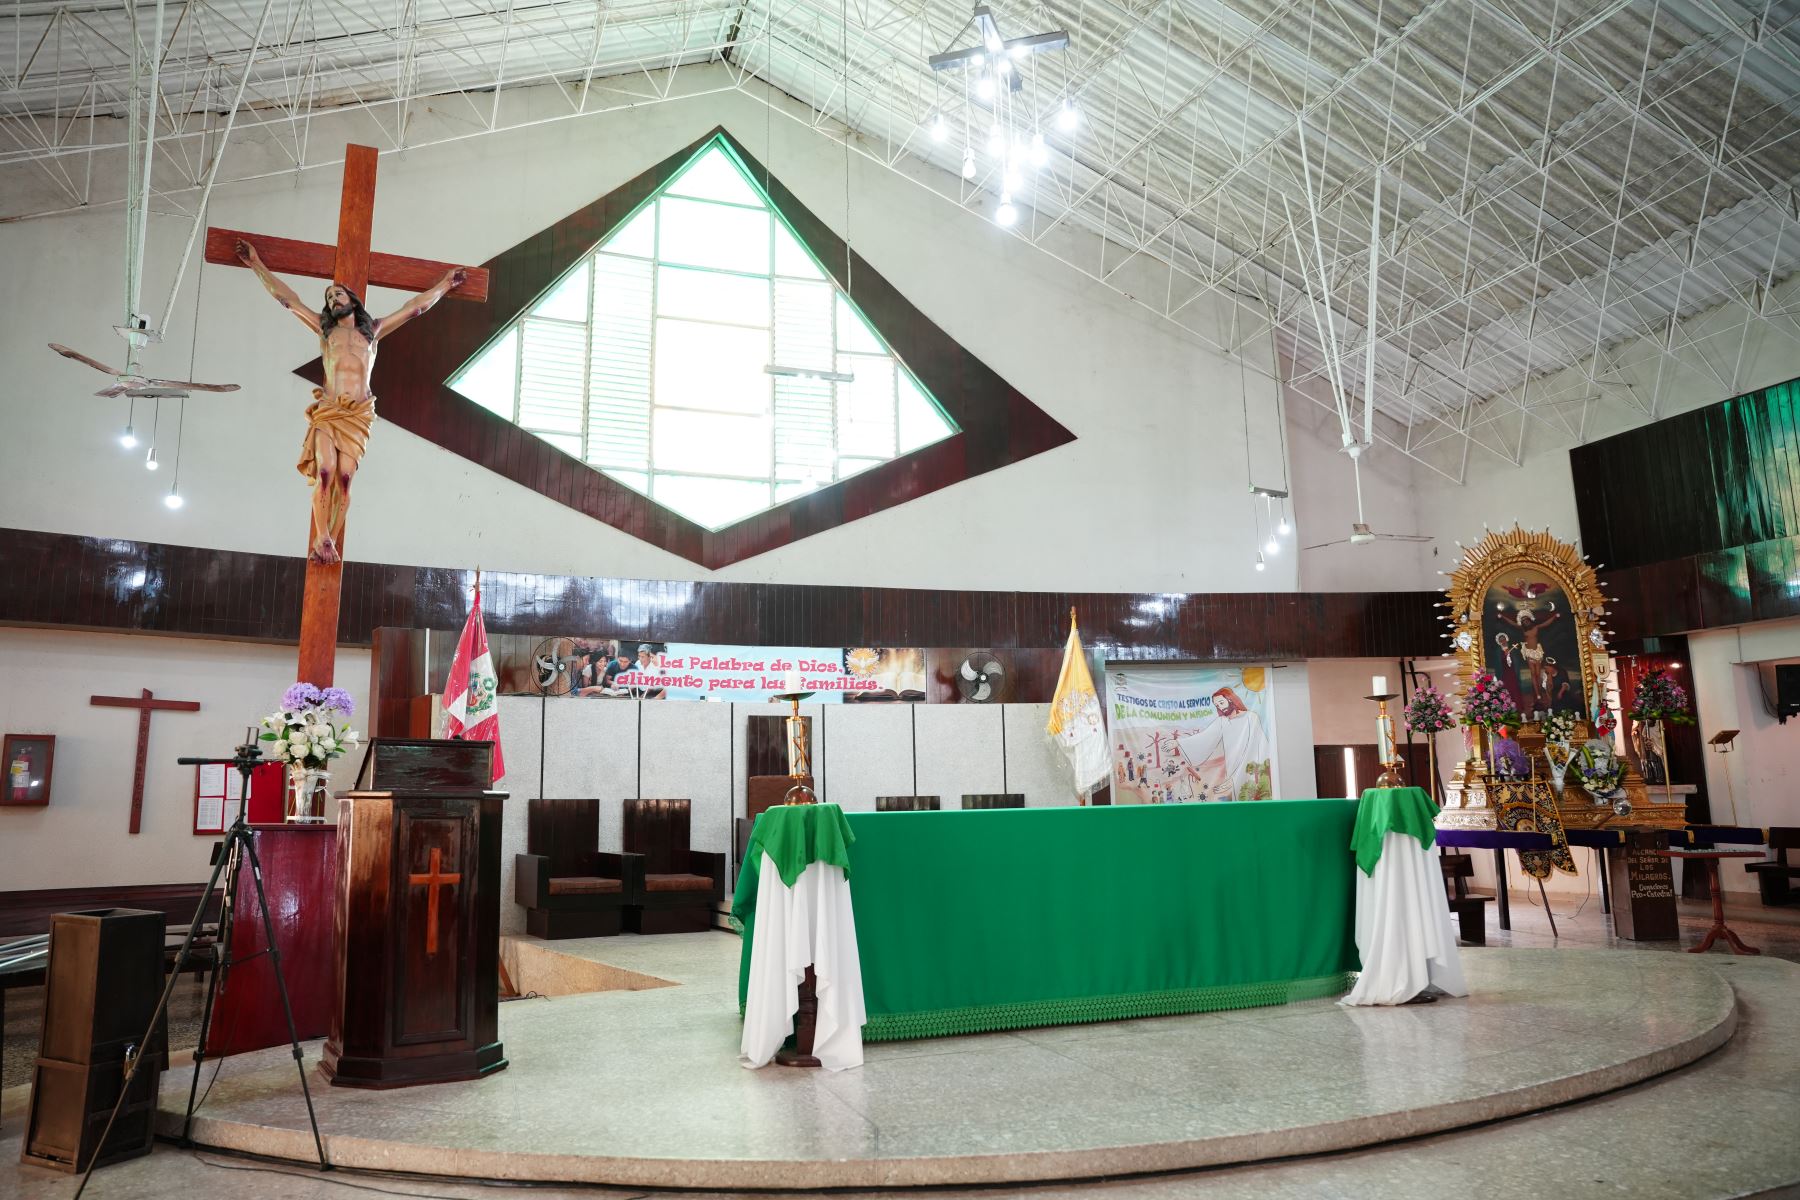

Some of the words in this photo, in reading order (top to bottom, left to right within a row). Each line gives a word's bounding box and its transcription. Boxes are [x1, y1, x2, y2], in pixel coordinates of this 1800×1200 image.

[659, 655, 683, 669] La
[689, 656, 765, 671] Palabra
[770, 659, 792, 671] de
[616, 671, 704, 688] alimento
[708, 677, 756, 691] para
[761, 676, 786, 690] las
[1117, 693, 1148, 708] TESTIGOS
[1149, 699, 1157, 708] DE
[1158, 699, 1178, 709] CRISTO
[1178, 700, 1186, 709] AL
[1186, 696, 1211, 709] SERVICIO
[1115, 703, 1126, 720] DE
[1127, 706, 1138, 718] LA
[1181, 712, 1188, 720] Y
